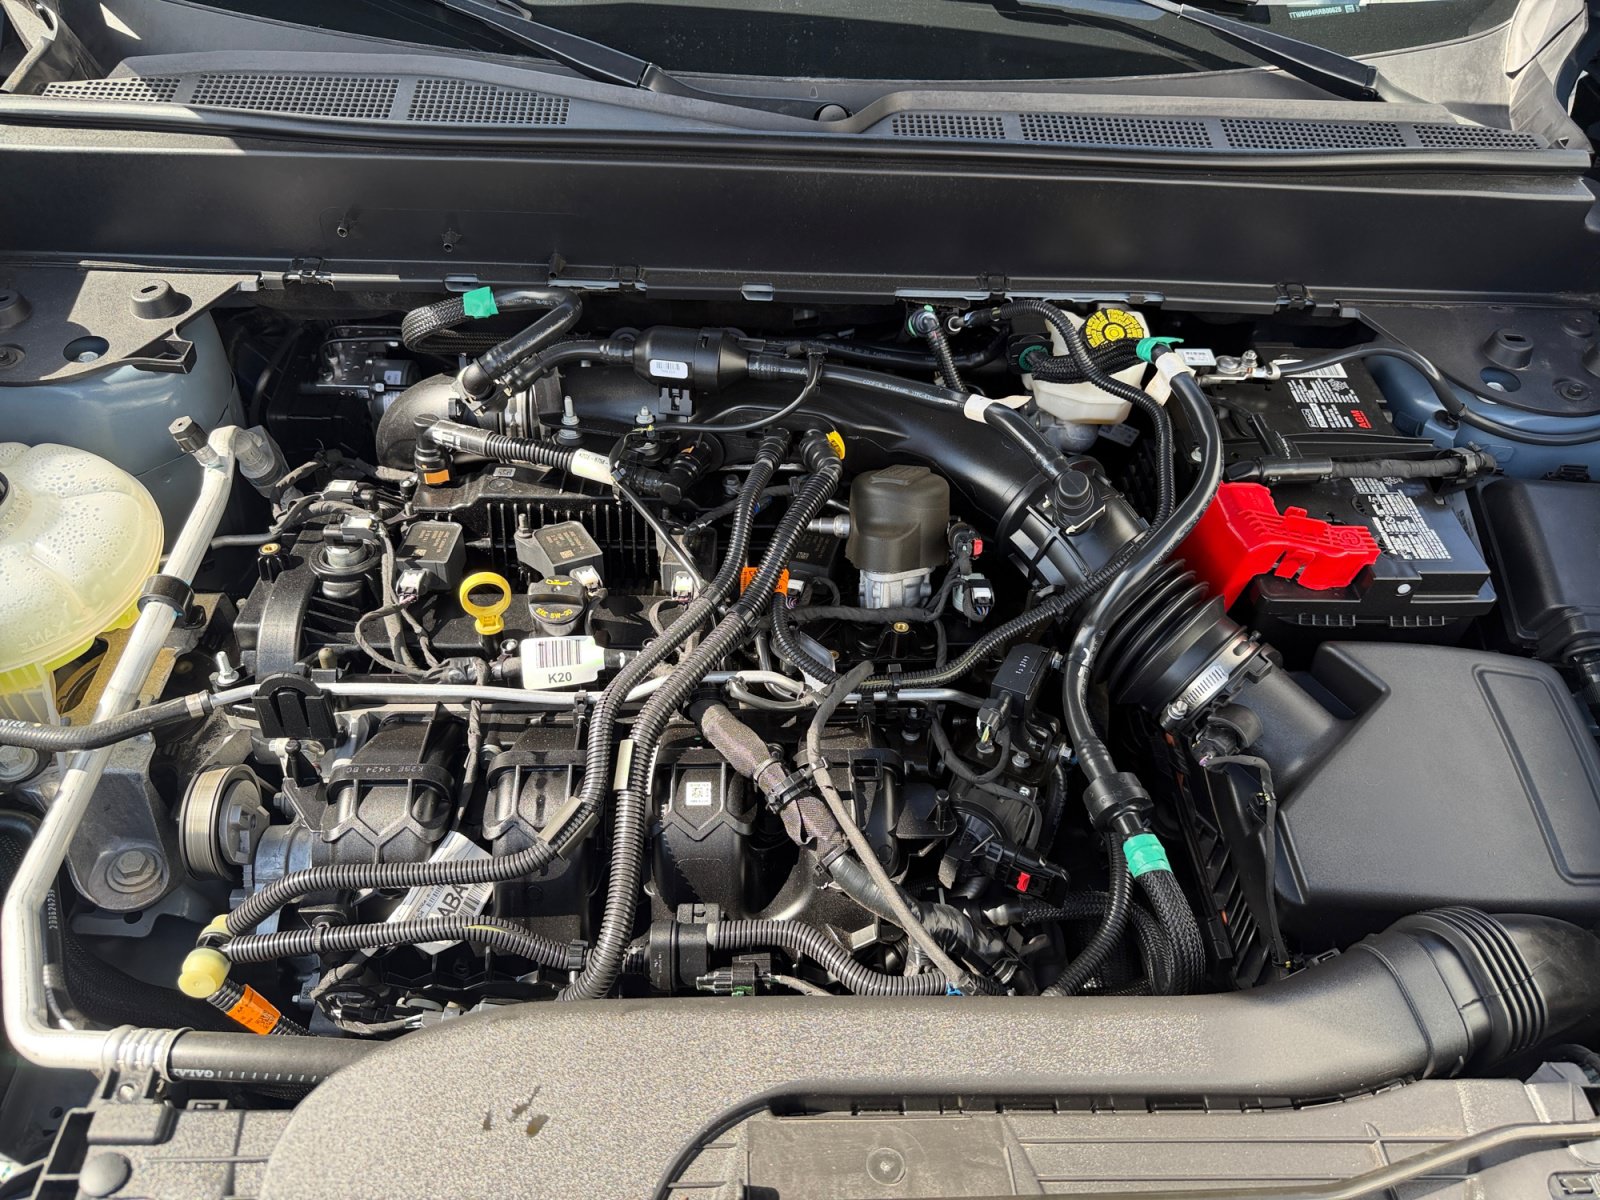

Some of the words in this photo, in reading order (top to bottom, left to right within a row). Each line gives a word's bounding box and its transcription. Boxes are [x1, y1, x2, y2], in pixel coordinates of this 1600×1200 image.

[1350, 410, 1370, 428] AGM
[548, 671, 572, 684] K20
[437, 884, 469, 917] ABA
